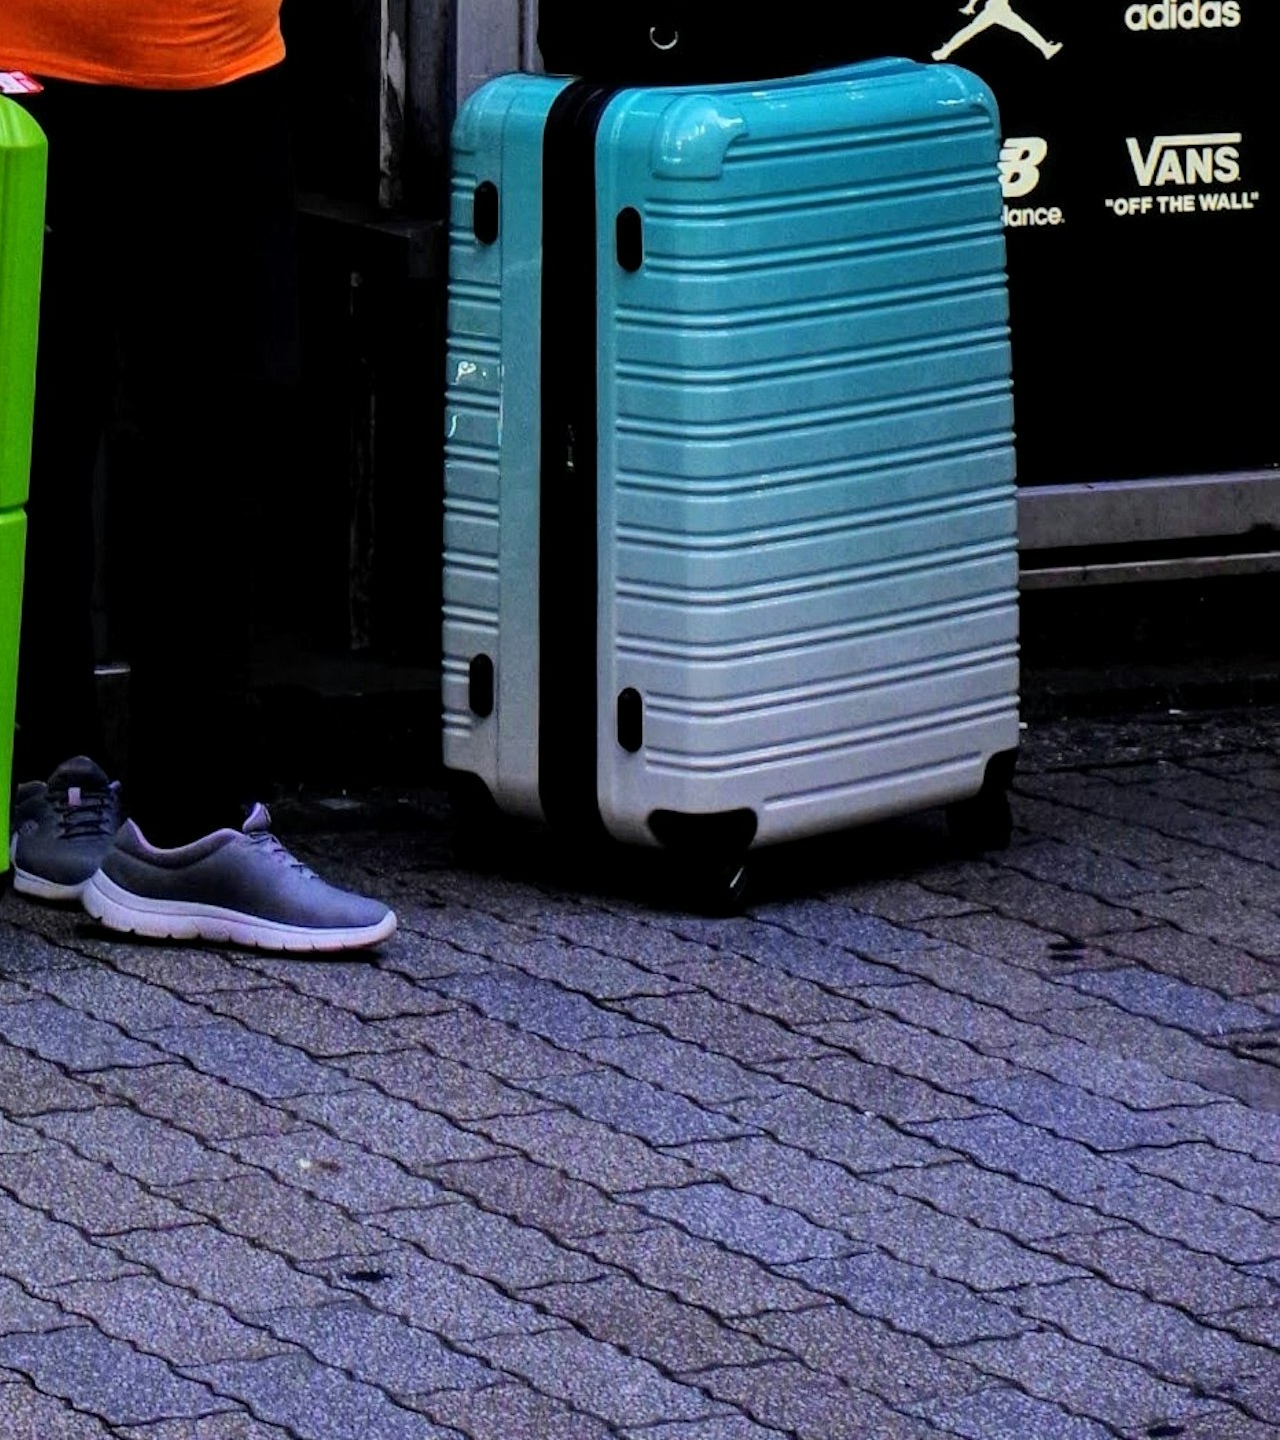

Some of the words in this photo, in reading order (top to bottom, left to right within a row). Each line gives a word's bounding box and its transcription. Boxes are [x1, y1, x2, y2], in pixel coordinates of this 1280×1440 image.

[1126, 133, 1242, 186] VANS
[1105, 197, 1153, 216] "OFF
[1156, 195, 1195, 213] THE
[1199, 192, 1259, 211] WALL"
